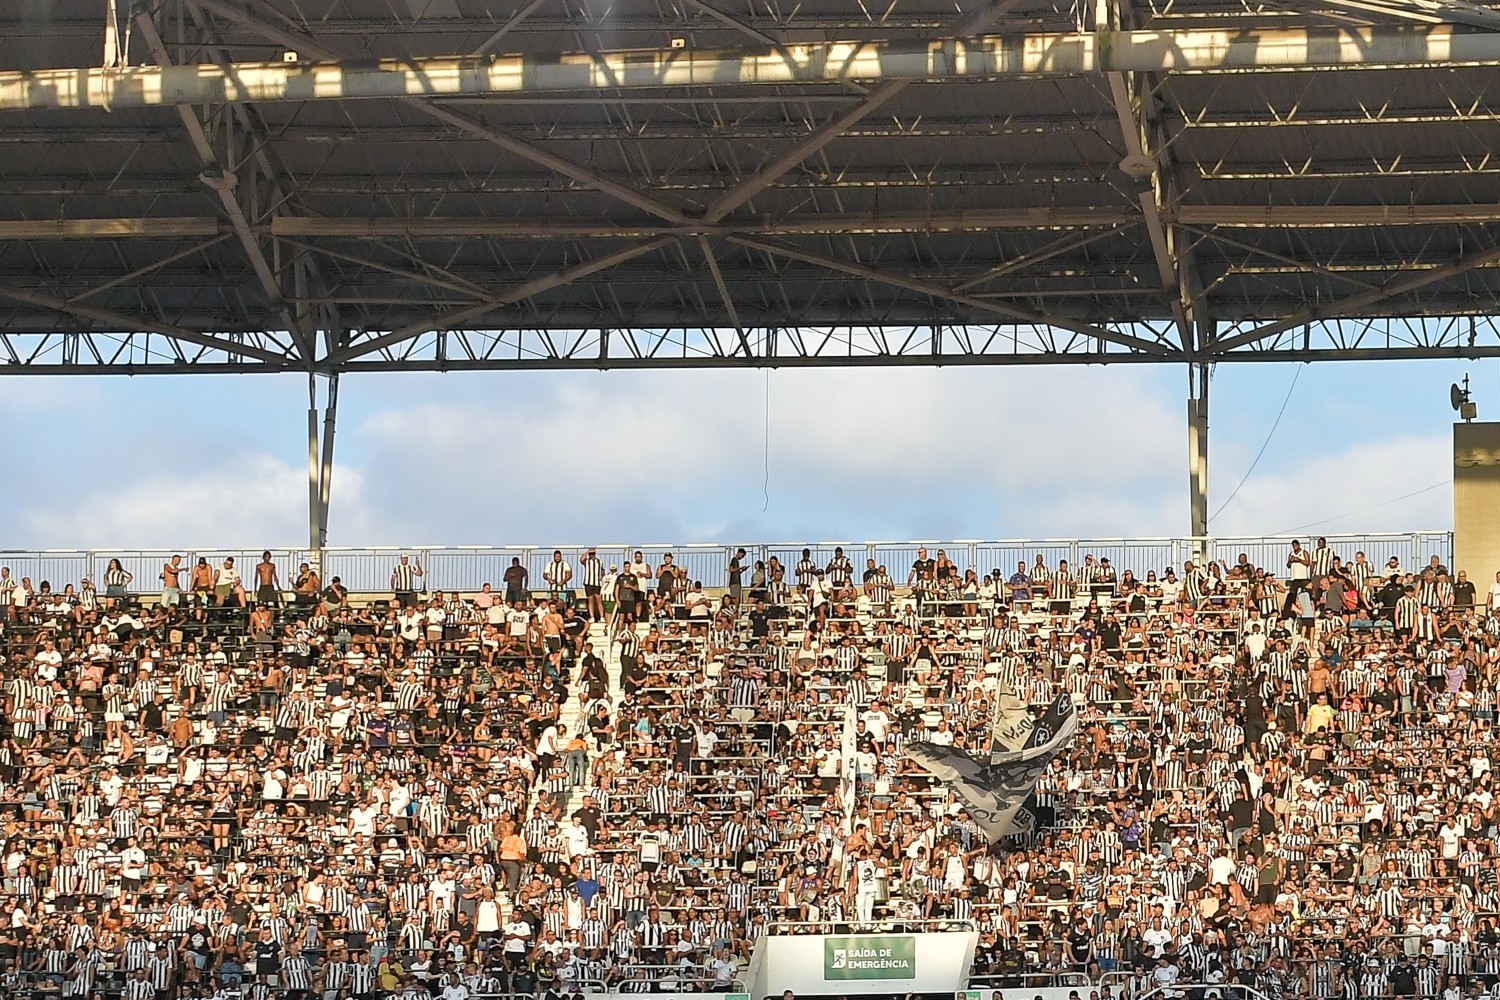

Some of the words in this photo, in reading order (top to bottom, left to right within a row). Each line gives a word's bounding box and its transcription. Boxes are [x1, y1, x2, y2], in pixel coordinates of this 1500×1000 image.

[848, 948, 877, 958] SAÍDA
[880, 949, 892, 957] DE
[848, 959, 909, 969] EMERGÊNCIA
